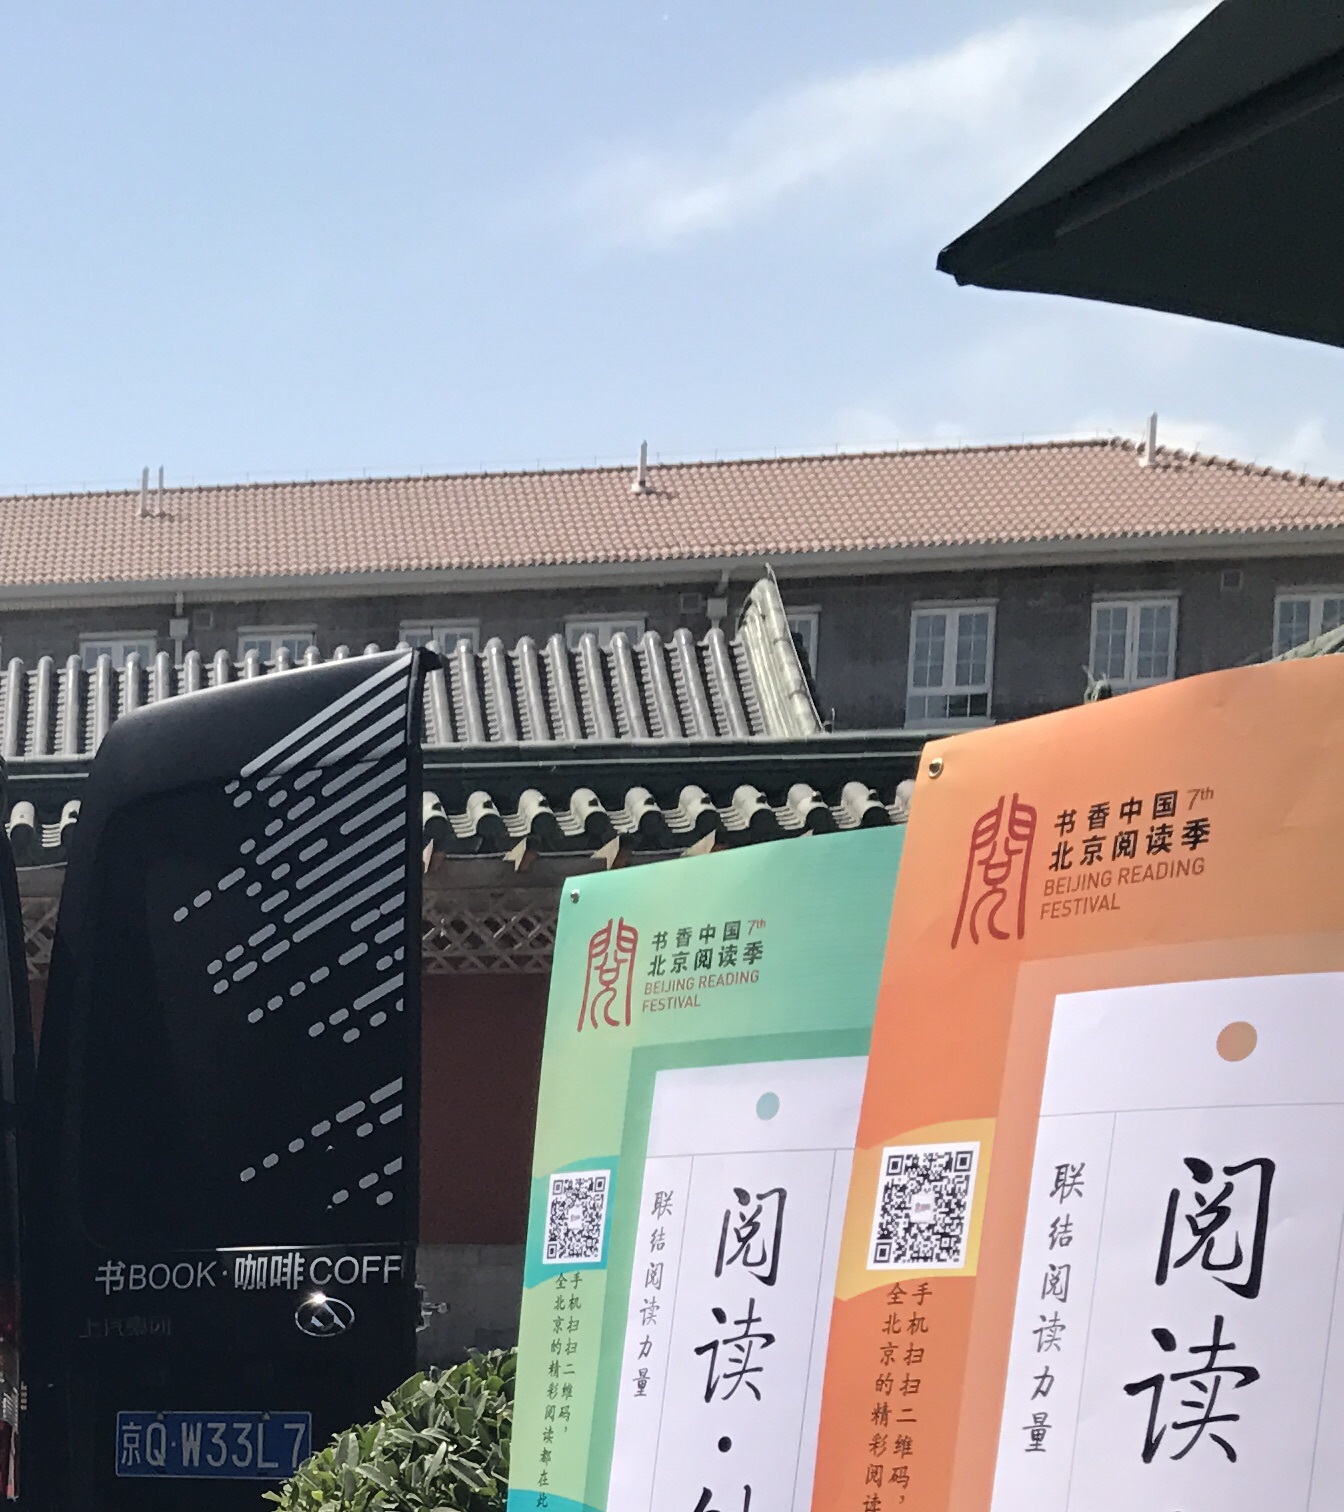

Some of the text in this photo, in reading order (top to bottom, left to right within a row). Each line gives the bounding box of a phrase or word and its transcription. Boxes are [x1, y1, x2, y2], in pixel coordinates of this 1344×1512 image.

[1053, 785, 1215, 838] 书香中国 7th
[1047, 817, 1212, 872] 北京阅读季
[1043, 856, 1206, 898] BEIJING READING
[1039, 893, 1122, 921] FESTIVAL
[650, 919, 767, 952] 书香中国 7th
[648, 941, 764, 978] 北京阅读季
[643, 969, 760, 995] BEIJING READING
[642, 995, 702, 1013] FESTIVAL
[632, 1189, 674, 1399] 联结阅读力量
[1021, 1162, 1086, 1454] 联结阅读力量
